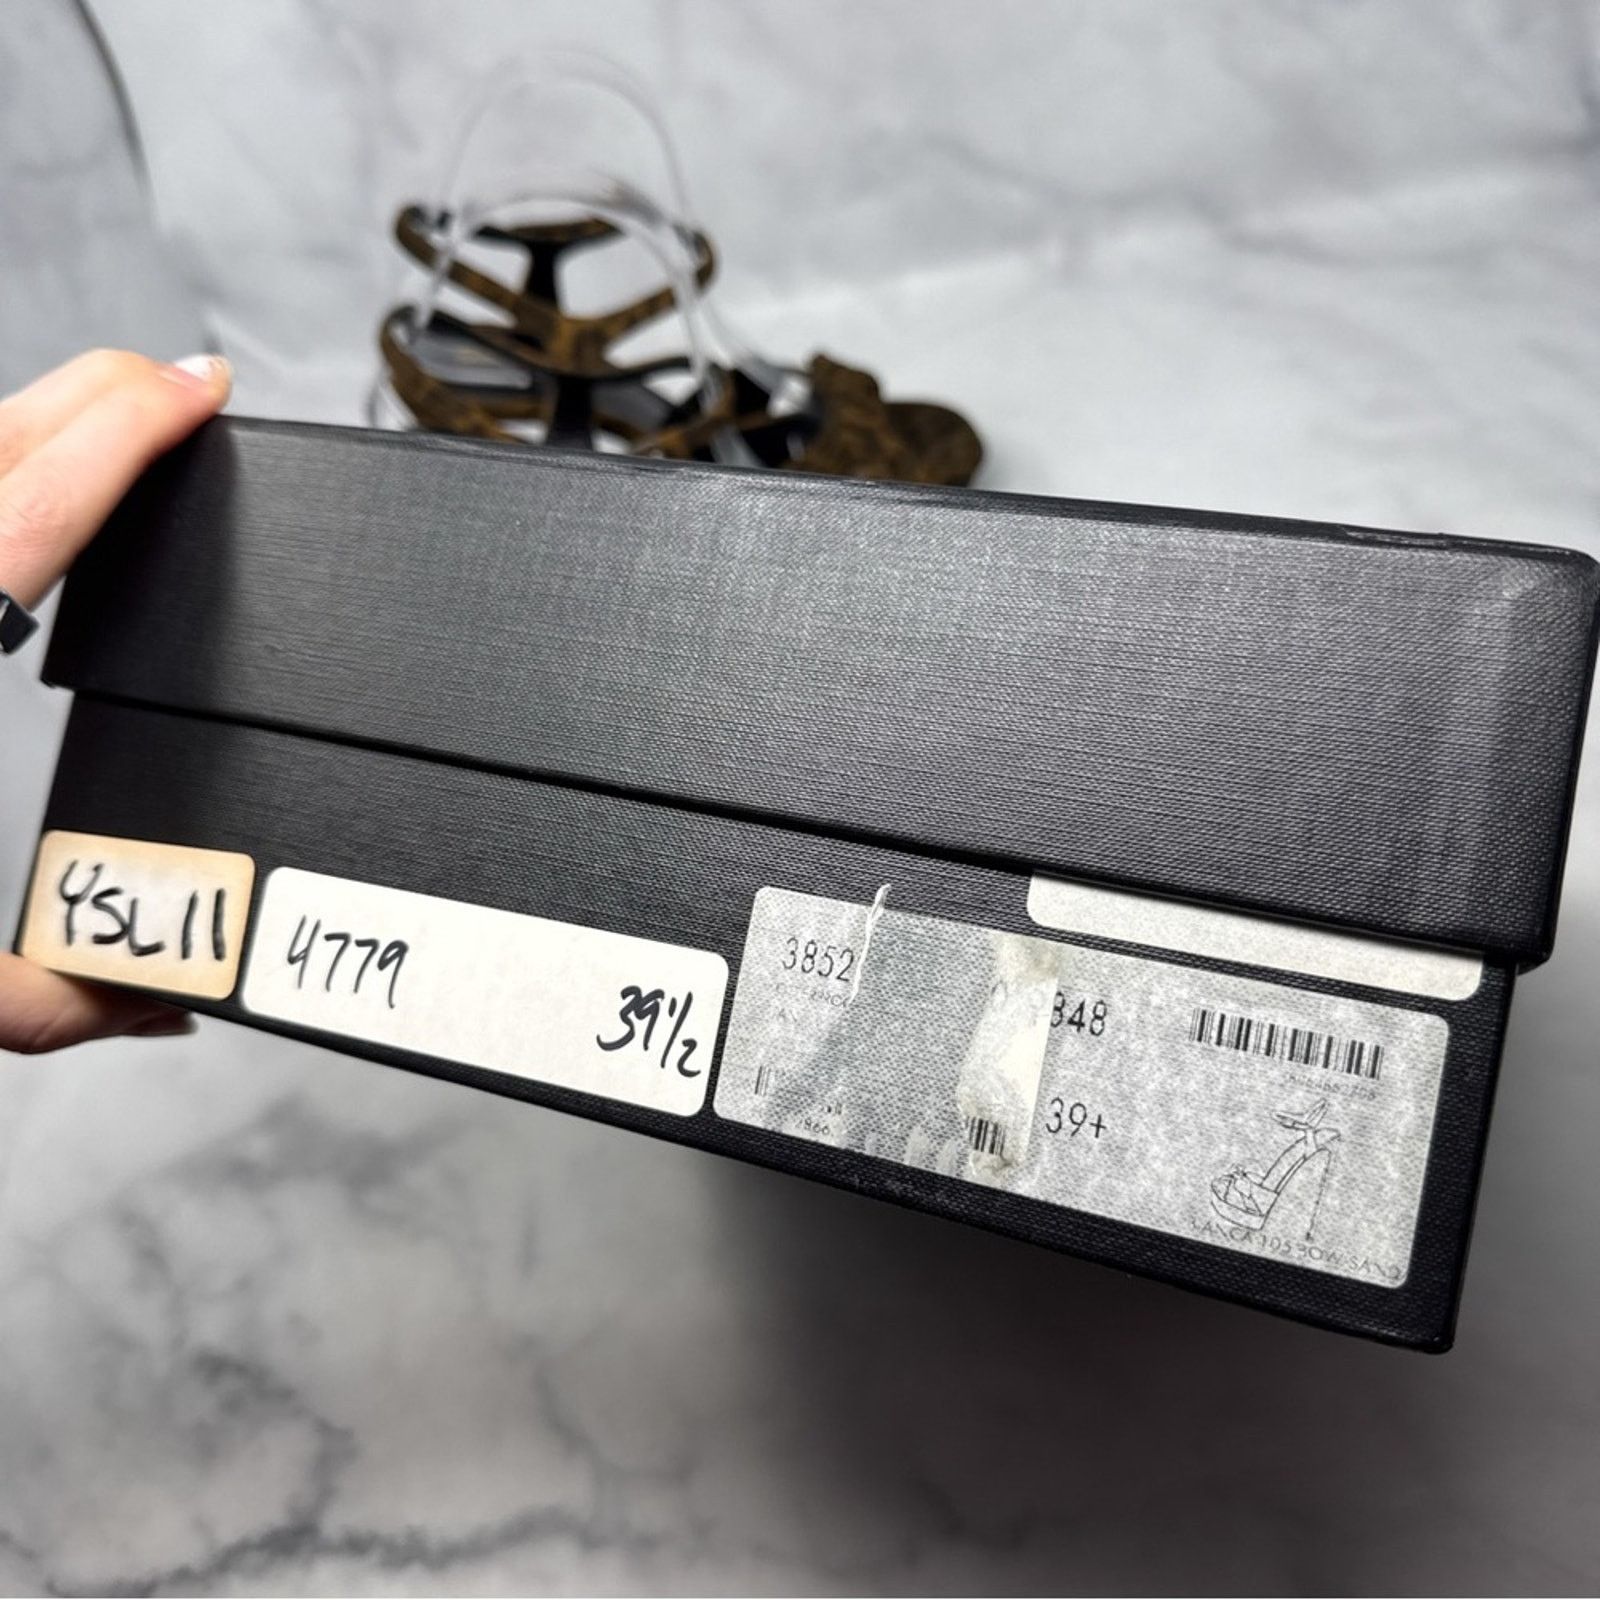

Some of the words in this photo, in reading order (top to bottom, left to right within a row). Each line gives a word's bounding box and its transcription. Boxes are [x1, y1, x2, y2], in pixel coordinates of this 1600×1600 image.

[59, 859, 165, 957] YSL
[286, 914, 409, 1009] 4779
[781, 936, 854, 982] 3852
[1045, 1096, 1107, 1139] 39+
